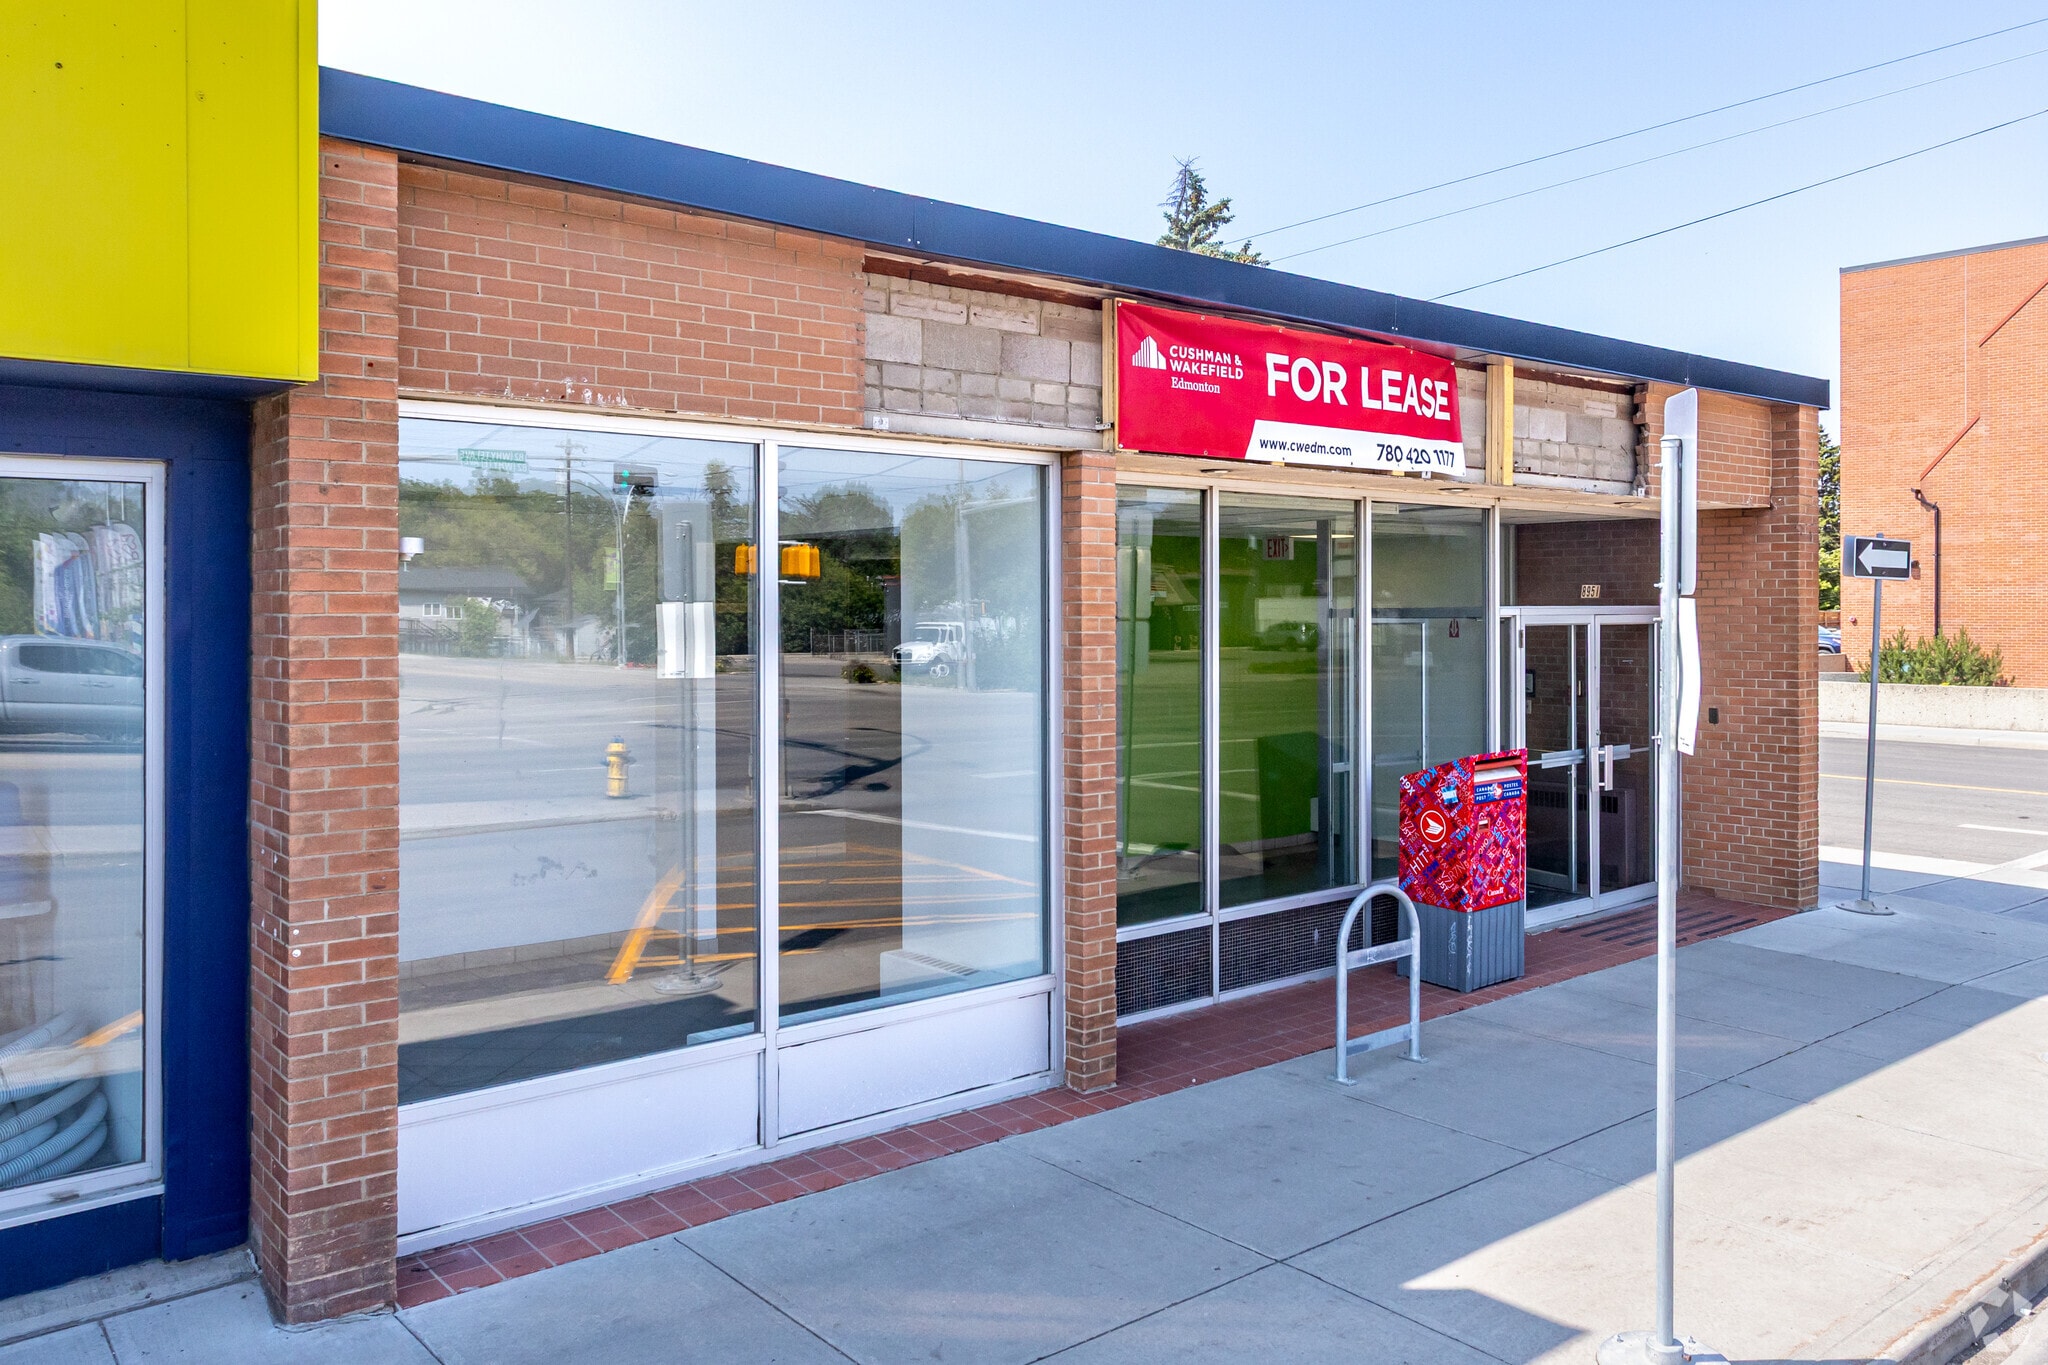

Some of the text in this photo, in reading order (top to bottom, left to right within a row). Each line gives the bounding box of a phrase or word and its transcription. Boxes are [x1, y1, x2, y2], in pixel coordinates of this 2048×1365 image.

[1169, 345, 1242, 365] CUSHMAN &
[1169, 359, 1244, 380] WAKEFIELD
[1171, 376, 1221, 394] Edmonton
[1265, 352, 1451, 421] FOR LEASE
[1259, 439, 1352, 457] www.cwedm.com
[1376, 443, 1455, 468] 780 420 1177
[1267, 538, 1285, 558] EXIT
[1582, 585, 1600, 597] 8951
[1399, 775, 1416, 796] H9X
[1409, 850, 1429, 875] H1T
